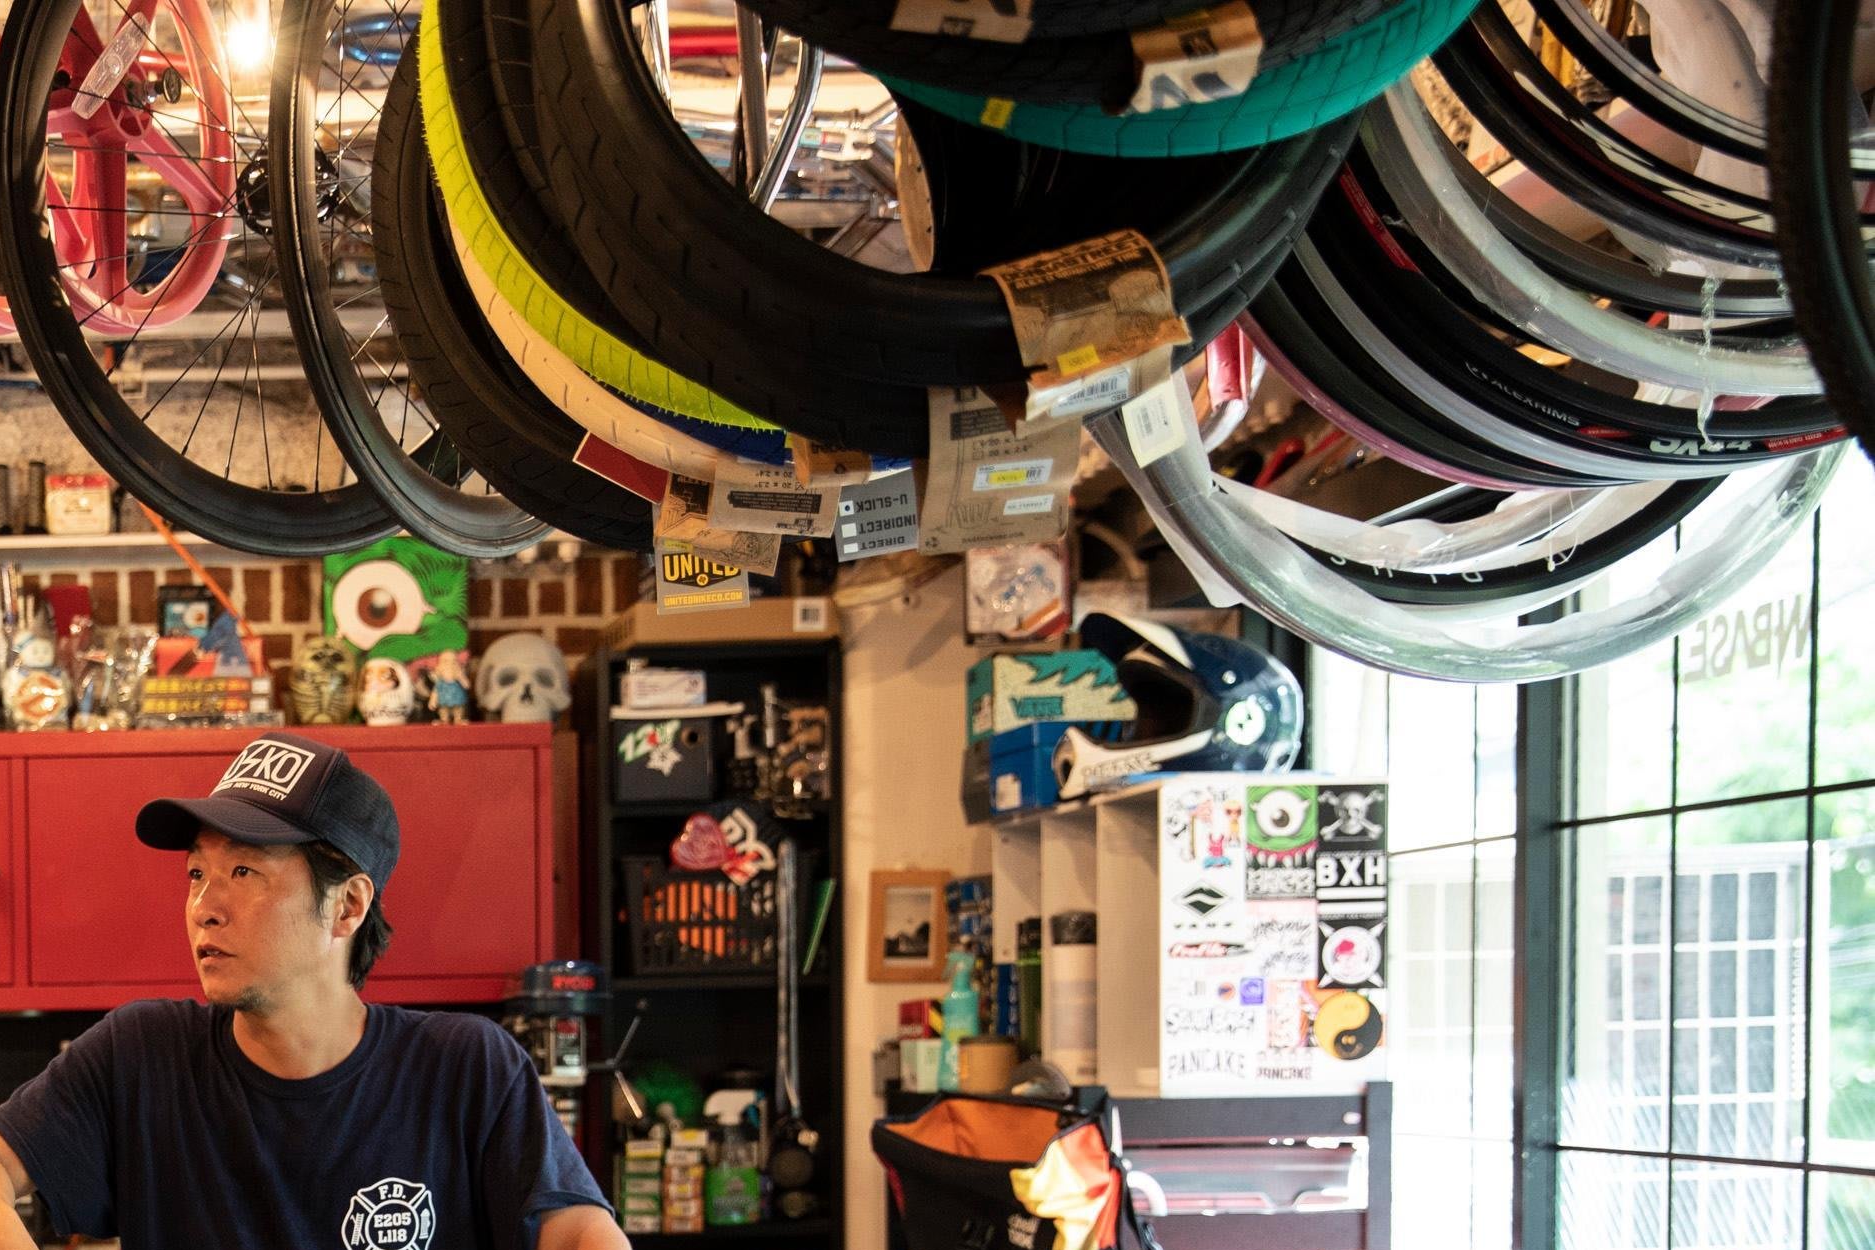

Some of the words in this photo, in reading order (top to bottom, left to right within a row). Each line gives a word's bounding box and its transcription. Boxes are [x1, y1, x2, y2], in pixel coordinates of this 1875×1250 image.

[1487, 376, 1581, 427] ALEXRIMS
[855, 493, 908, 514] U-SLICK
[859, 513, 917, 535] INDIRECT
[860, 535, 905, 552] DIRECT
[663, 553, 740, 582] UNITED
[233, 781, 250, 789] NEW
[249, 783, 269, 795] YORK
[268, 788, 287, 801] CITY
[1315, 854, 1387, 887] BXH
[1256, 1066, 1313, 1081] PANCAKE
[378, 1184, 407, 1201] F.D.
[373, 1212, 412, 1228] E205
[378, 1229, 408, 1244] L118
